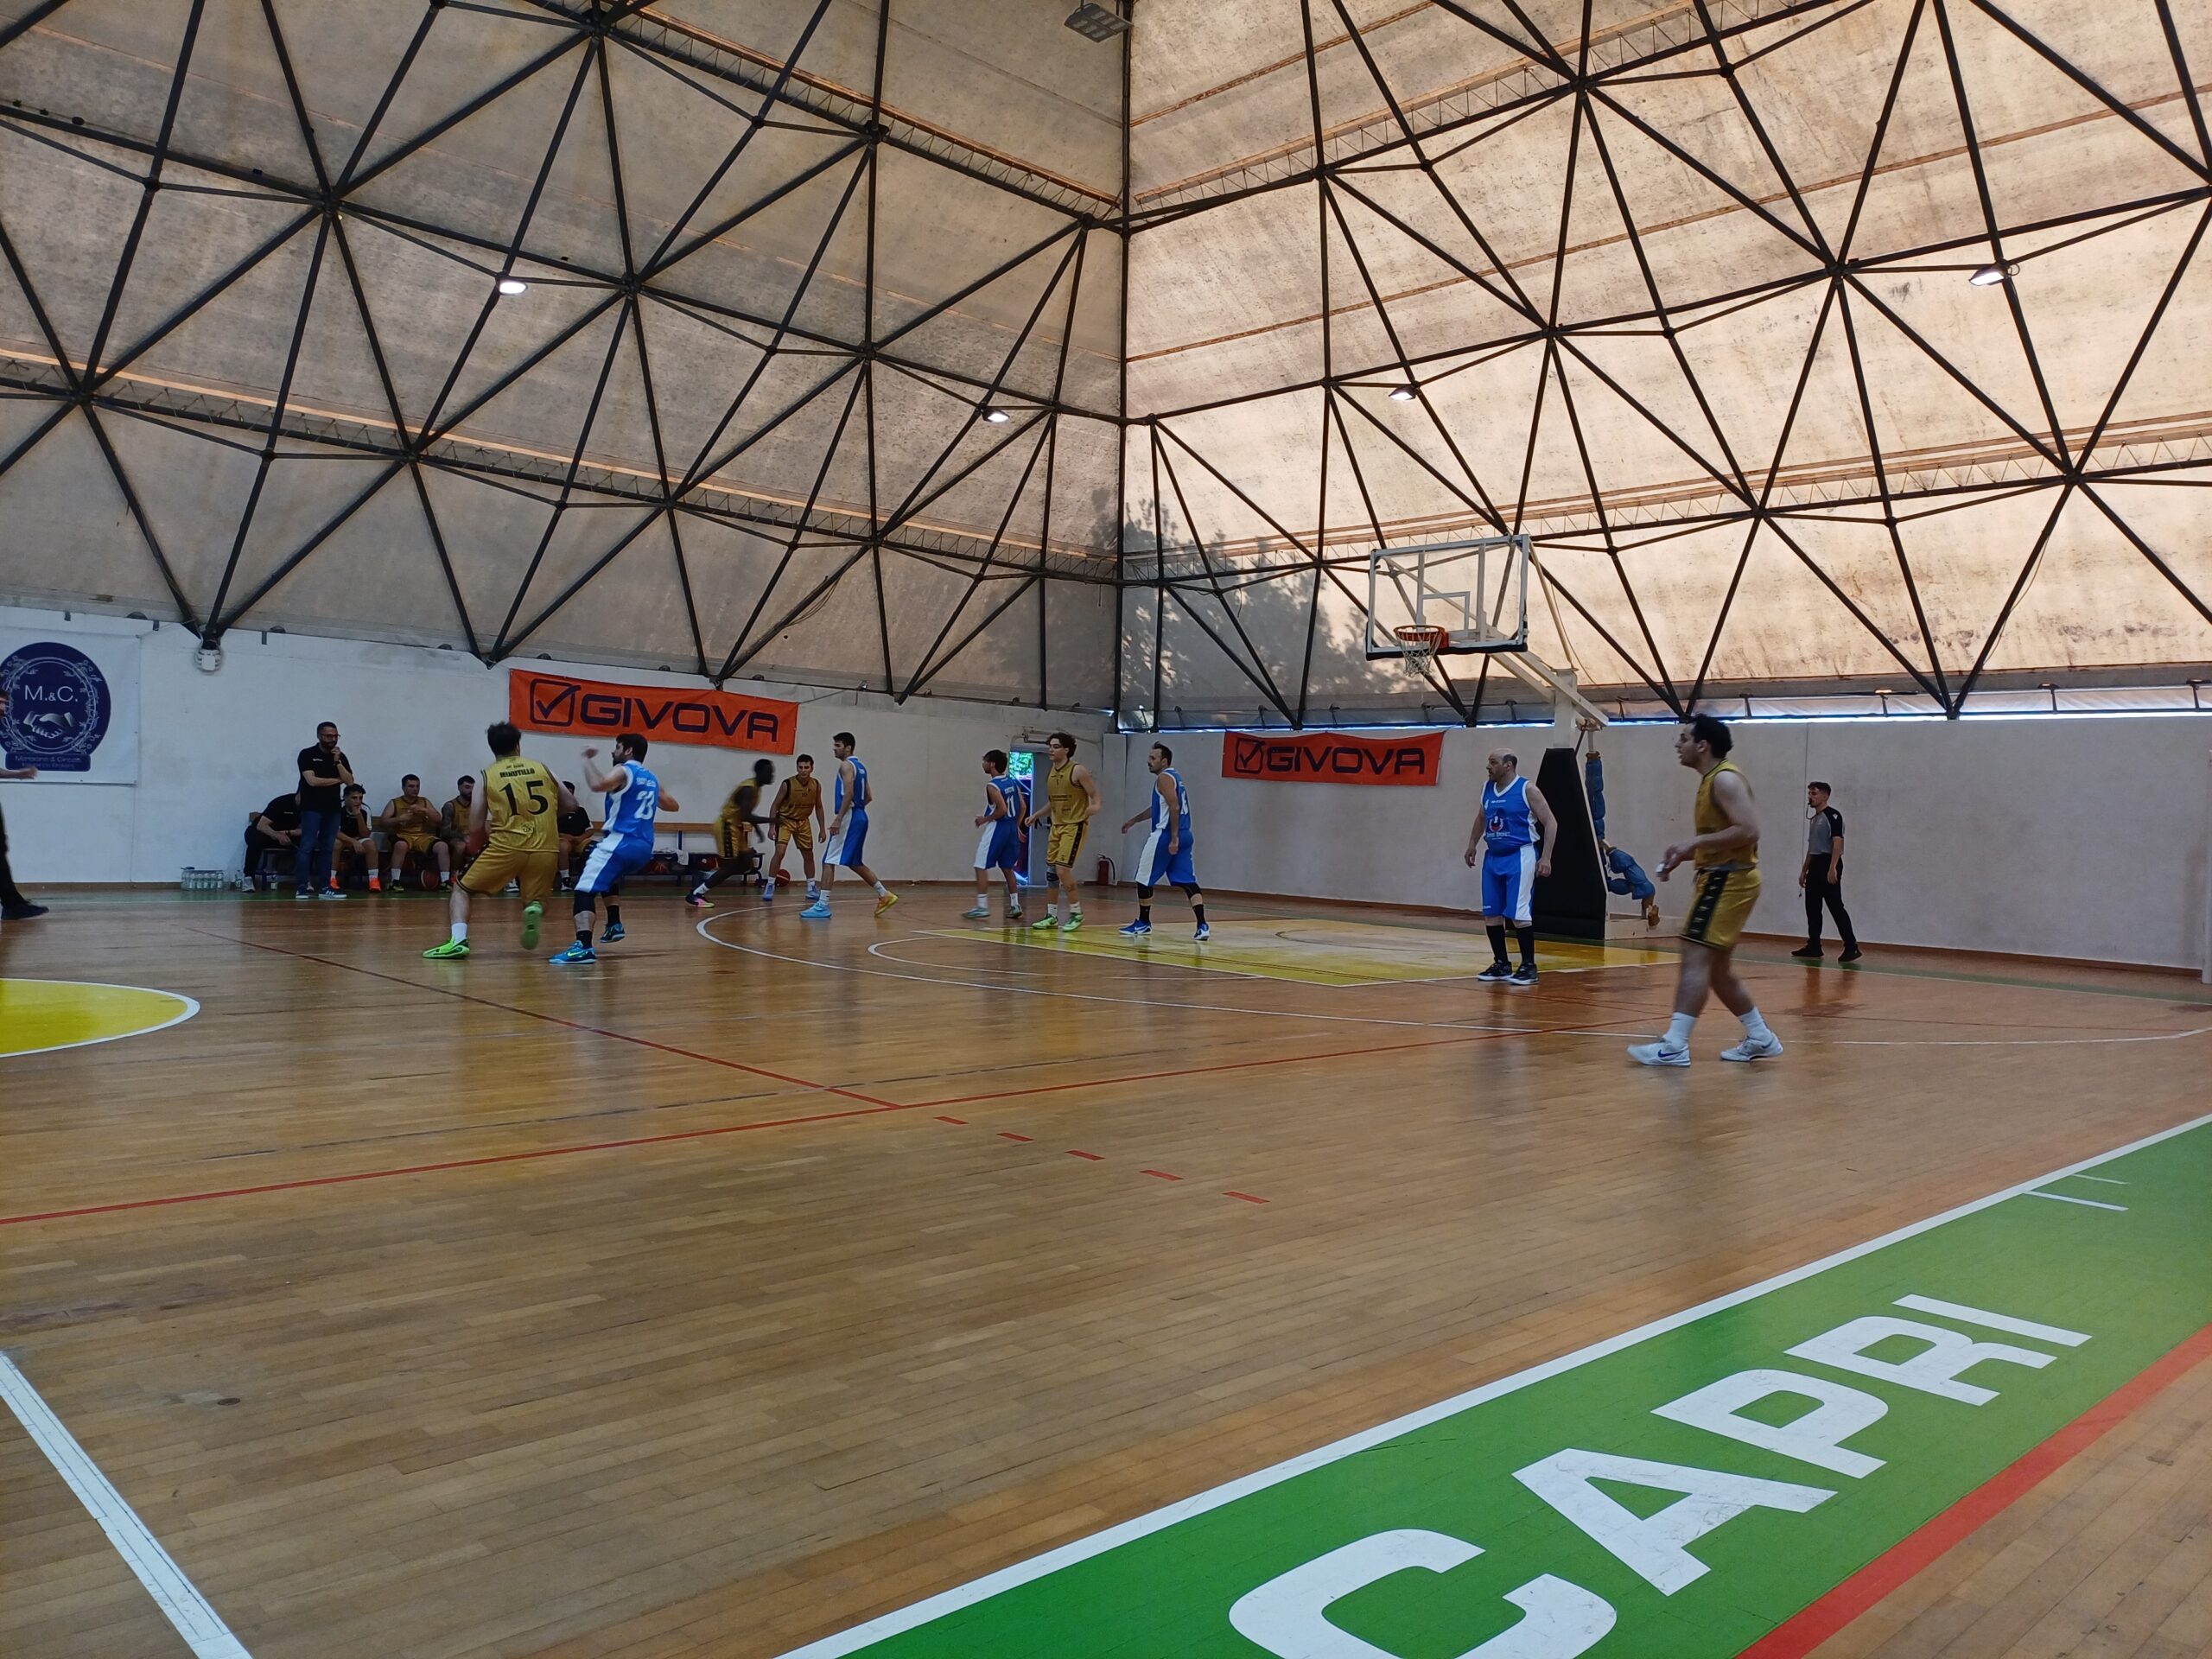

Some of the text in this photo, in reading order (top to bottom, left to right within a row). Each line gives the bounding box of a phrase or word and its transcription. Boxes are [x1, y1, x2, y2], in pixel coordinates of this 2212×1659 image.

[580, 693, 779, 742] GIVOVA
[1266, 745, 1426, 775] GIVOVA
[499, 779, 550, 817] 15
[1006, 794, 1016, 818] 11
[1229, 1294, 2092, 1659] CAPRI
